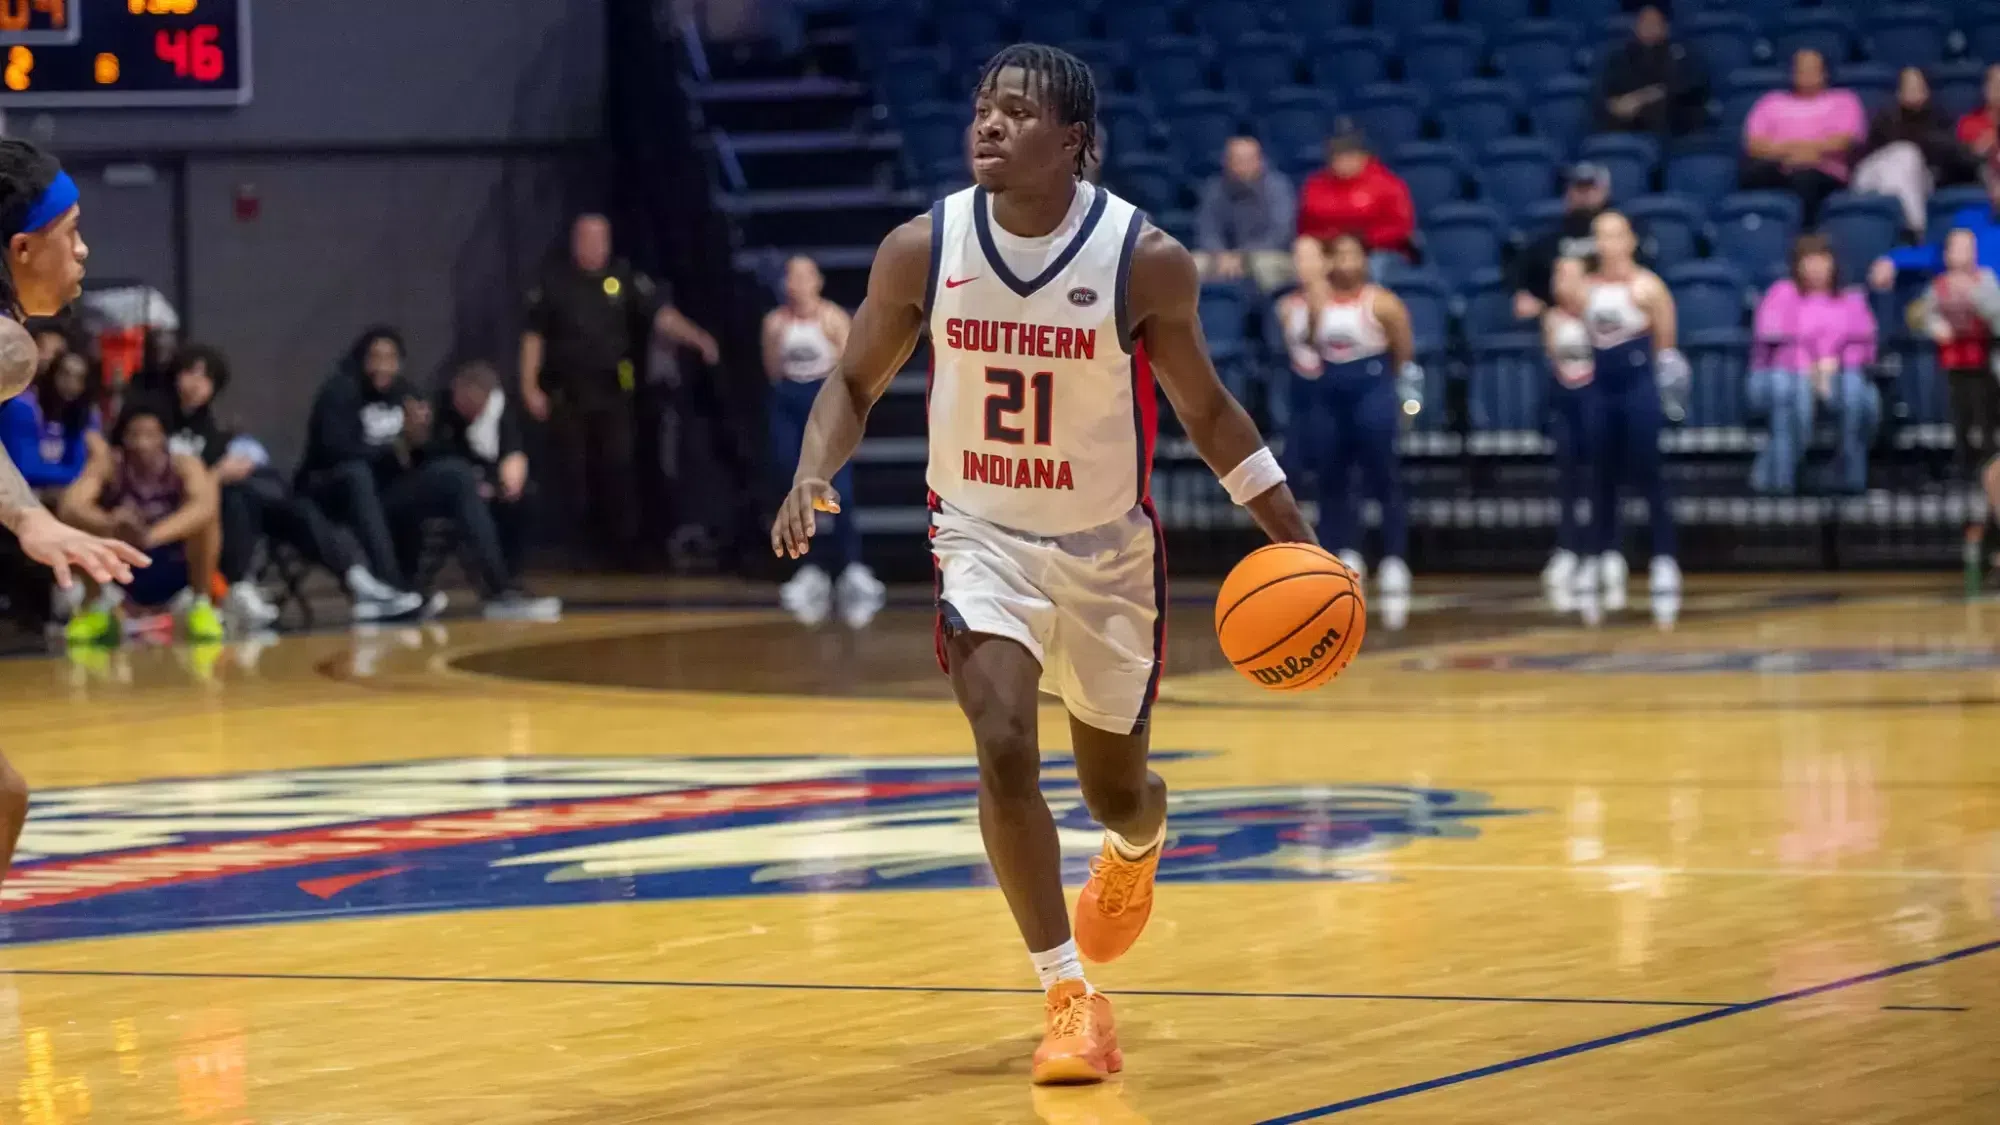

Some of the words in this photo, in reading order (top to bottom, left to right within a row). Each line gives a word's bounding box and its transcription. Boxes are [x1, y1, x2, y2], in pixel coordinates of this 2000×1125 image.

[155, 24, 224, 81] 46
[1073, 291, 1093, 302] OVC
[946, 318, 1096, 360] SOUTHERN
[984, 366, 1053, 446] 21
[963, 449, 1074, 490] INDIANA
[1248, 627, 1341, 686] Wilson
